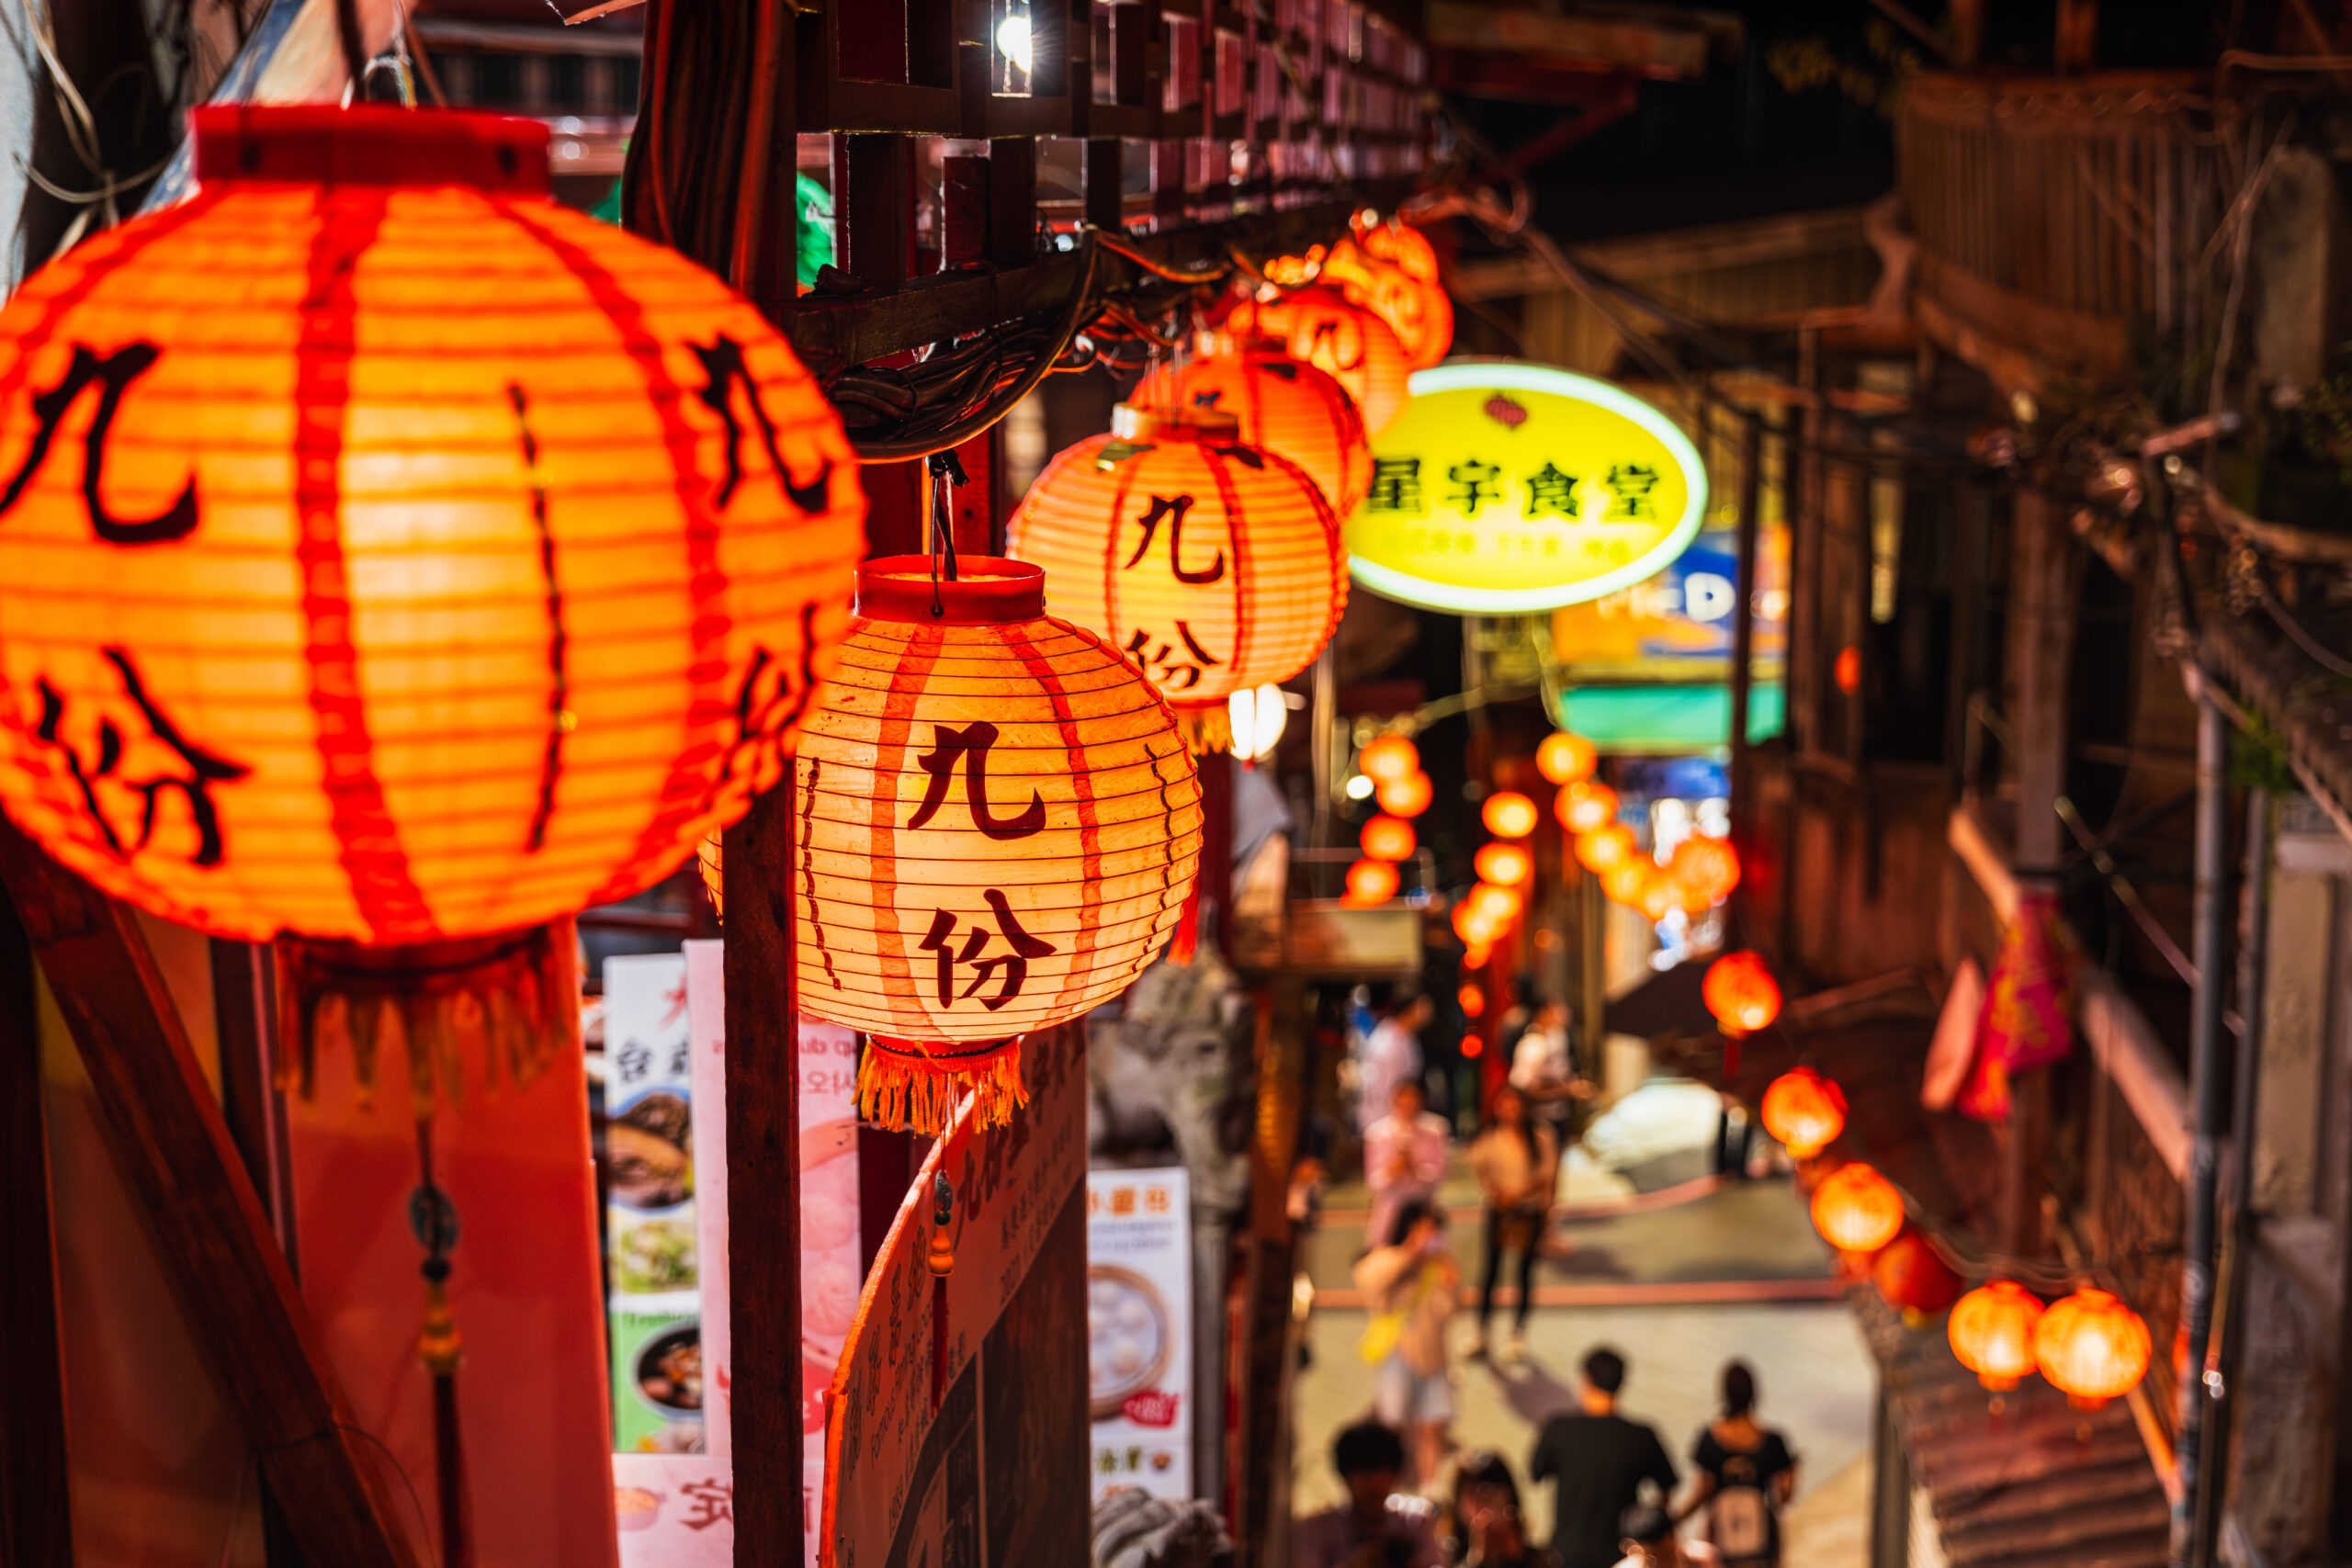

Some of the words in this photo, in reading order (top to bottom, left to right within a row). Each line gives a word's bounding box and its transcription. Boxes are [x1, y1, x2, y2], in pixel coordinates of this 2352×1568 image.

[1369, 457, 1659, 521] 星宇食堂
[1126, 494, 1238, 689] 九份
[908, 721, 1057, 1011] 九份
